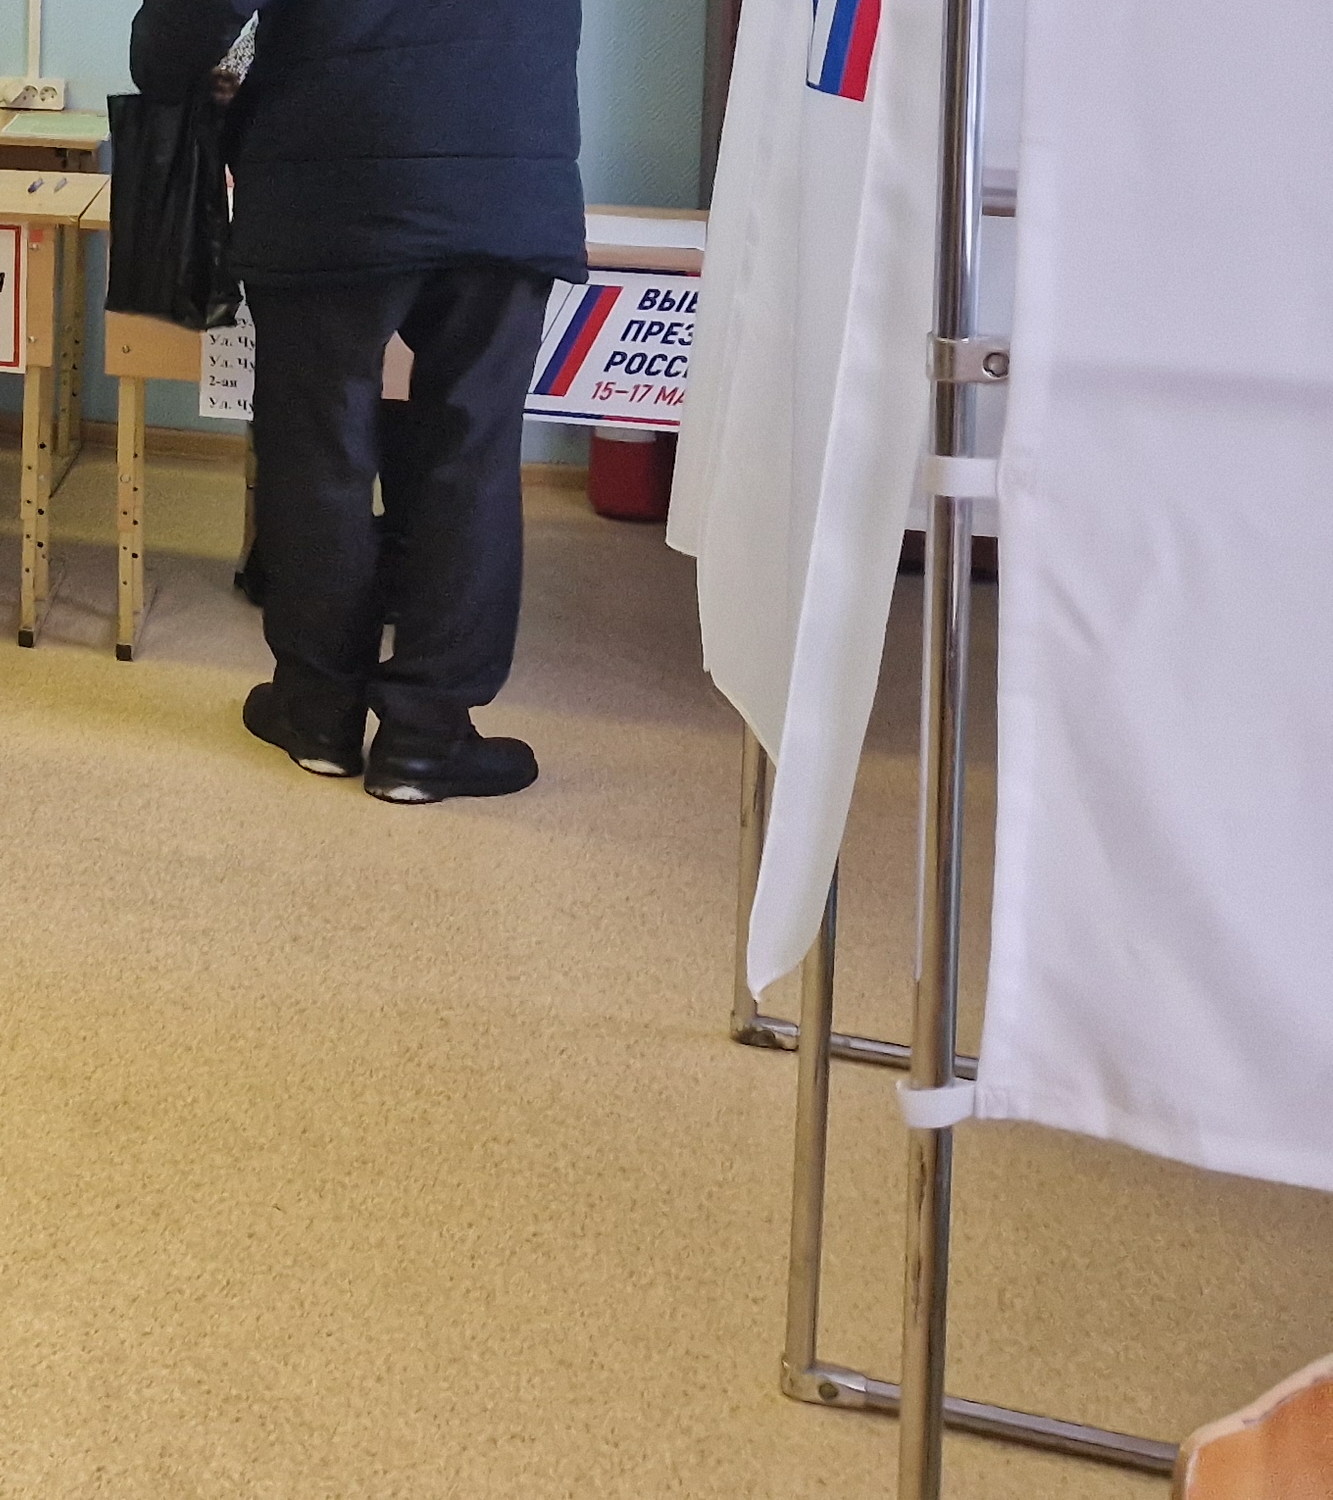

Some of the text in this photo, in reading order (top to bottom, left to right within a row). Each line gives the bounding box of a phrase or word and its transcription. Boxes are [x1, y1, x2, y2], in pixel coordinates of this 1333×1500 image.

[209, 334, 233, 346] Ул.
[209, 355, 233, 368] Ул.
[603, 351, 689, 378] РОСС
[209, 397, 232, 410] Ул.
